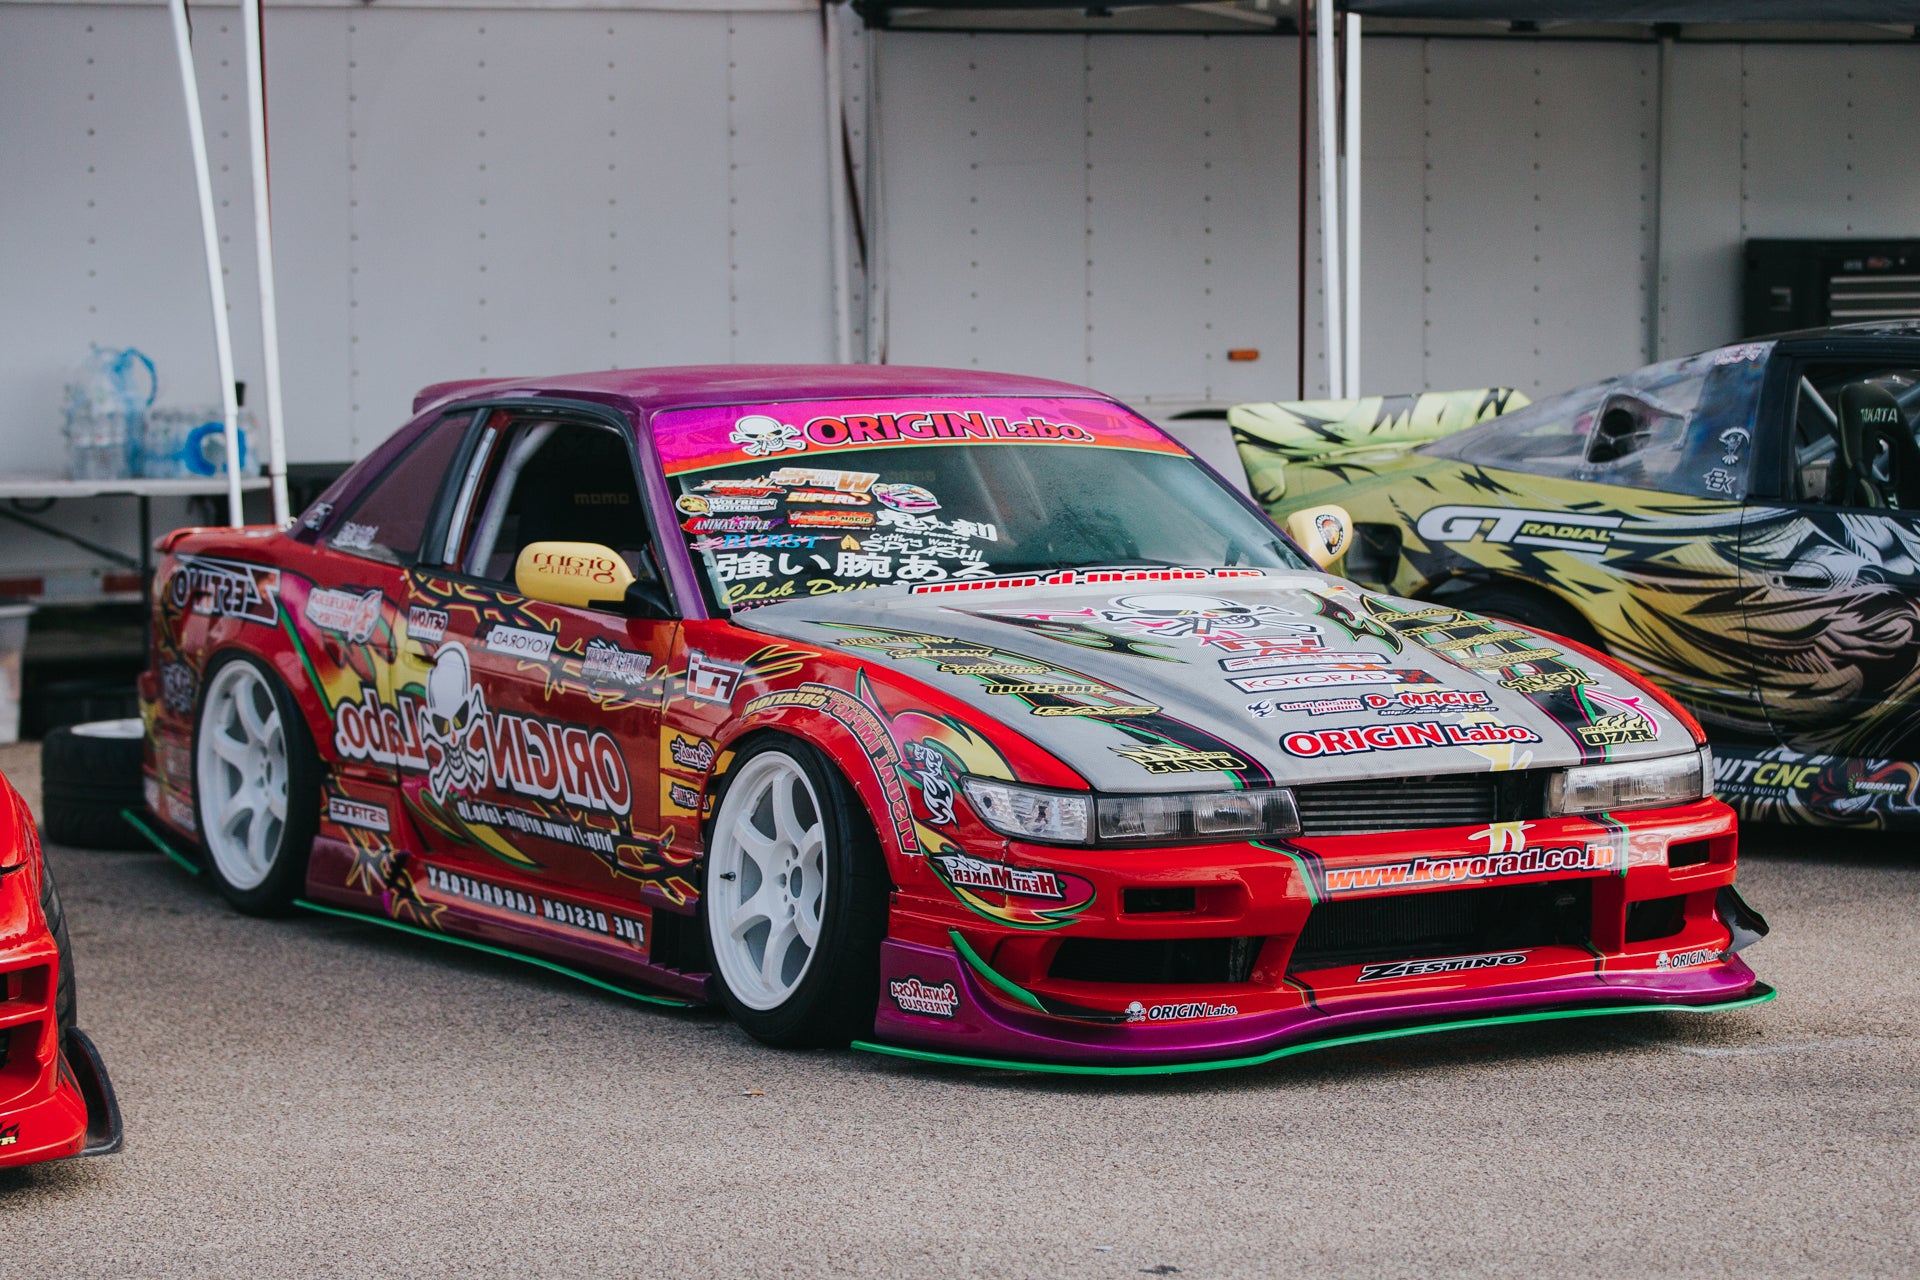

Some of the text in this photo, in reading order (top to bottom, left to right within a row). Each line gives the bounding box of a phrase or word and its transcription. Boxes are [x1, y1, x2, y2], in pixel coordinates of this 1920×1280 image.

[1860, 407, 1898, 424] TAKATA
[805, 412, 1096, 445] ORIGIN Labo.
[573, 492, 630, 505] momo
[694, 518, 771, 531] ANIMAL STYLE
[1417, 504, 1623, 544] GT RADIAL
[721, 533, 820, 549] BURST
[869, 533, 923, 548] Cutting
[1244, 673, 1388, 689] KOYORAD
[1281, 698, 1358, 711] total design
[1366, 690, 1491, 709] D-MAGIC
[1312, 703, 1362, 715] produce
[1285, 722, 1537, 757] ORIGIN Labo.
[1582, 729, 1657, 746] 07R
[1714, 783, 1786, 797] ESIGN BUILD
[1854, 780, 1907, 792] VIBRANT
[1326, 844, 1616, 892] www.koyorad.co.jp
[1356, 950, 1528, 983] ZESTINO
[1672, 948, 1721, 969] ORIGIN Lab
[1148, 1002, 1238, 1021] ORIGIN Labo.
